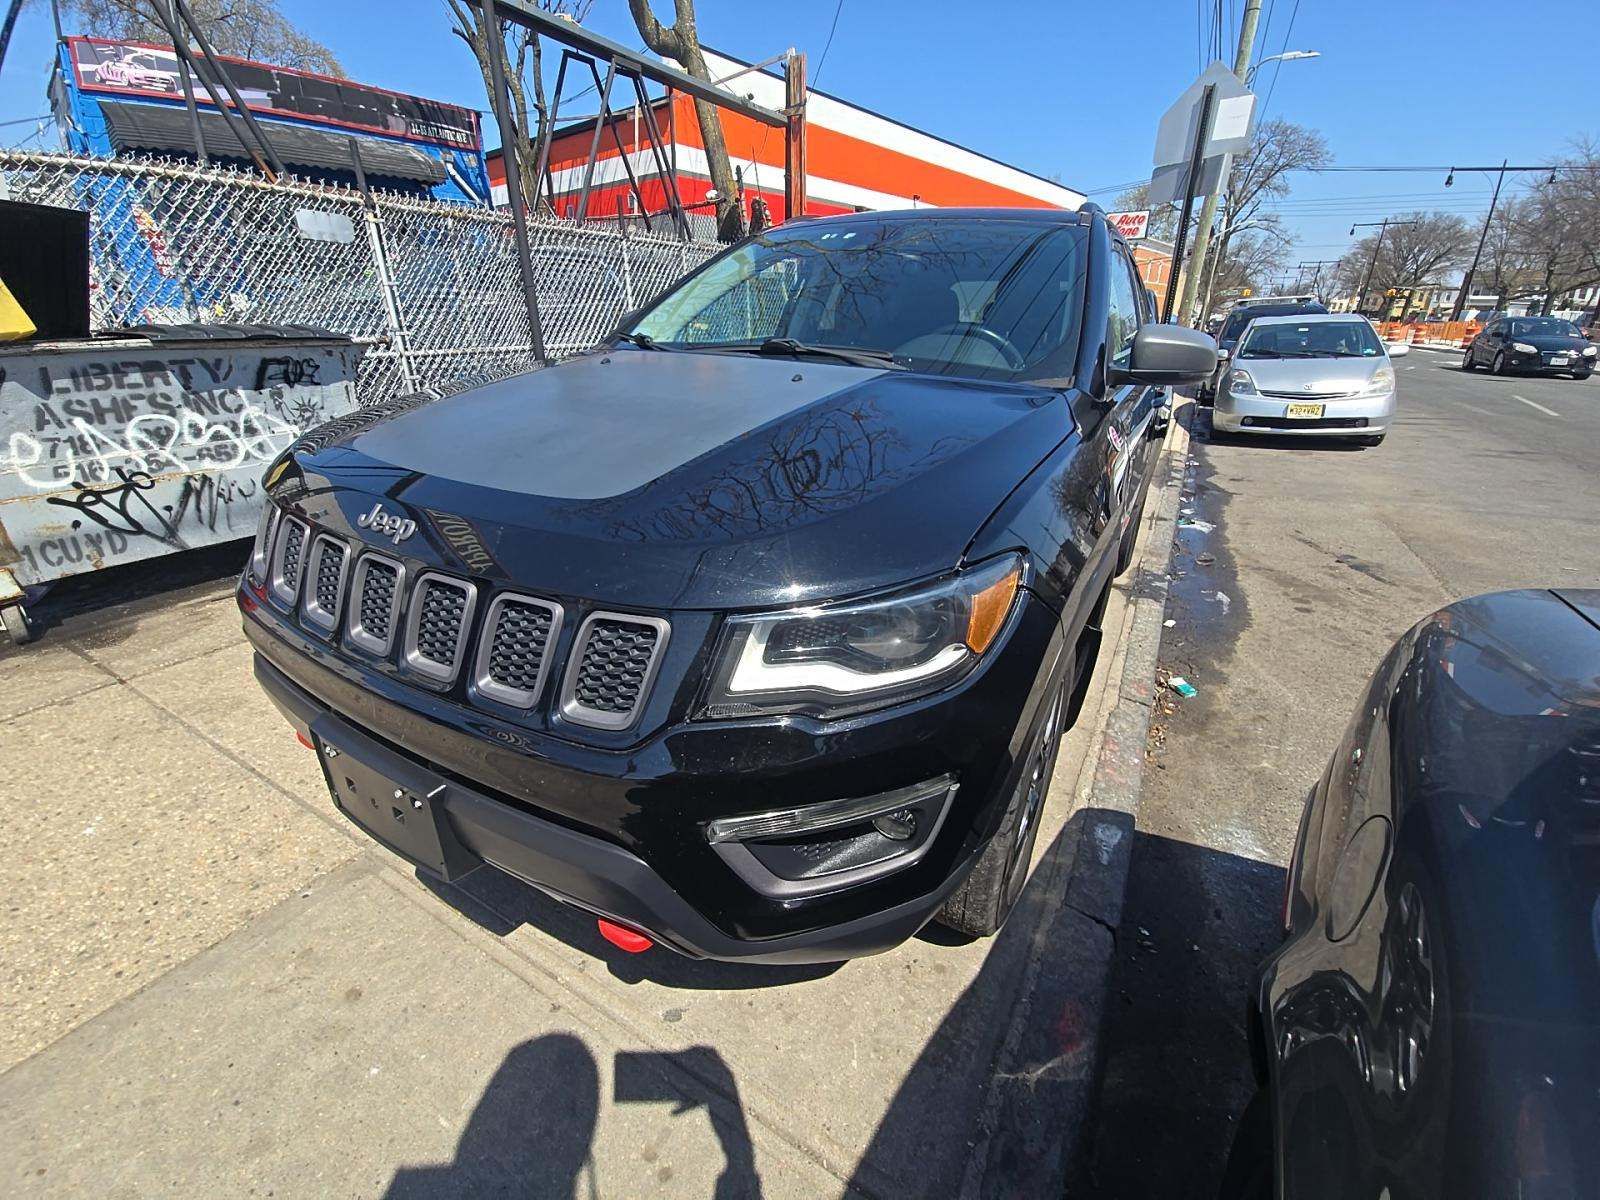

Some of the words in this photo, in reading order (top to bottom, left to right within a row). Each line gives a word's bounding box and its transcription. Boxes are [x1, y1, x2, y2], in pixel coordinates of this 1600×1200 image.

[1117, 214, 1145, 225] Auto
[1118, 226, 1140, 236] one
[39, 357, 234, 396] LIBERTY
[35, 391, 177, 432] ASHES
[357, 503, 418, 545] Jeep
